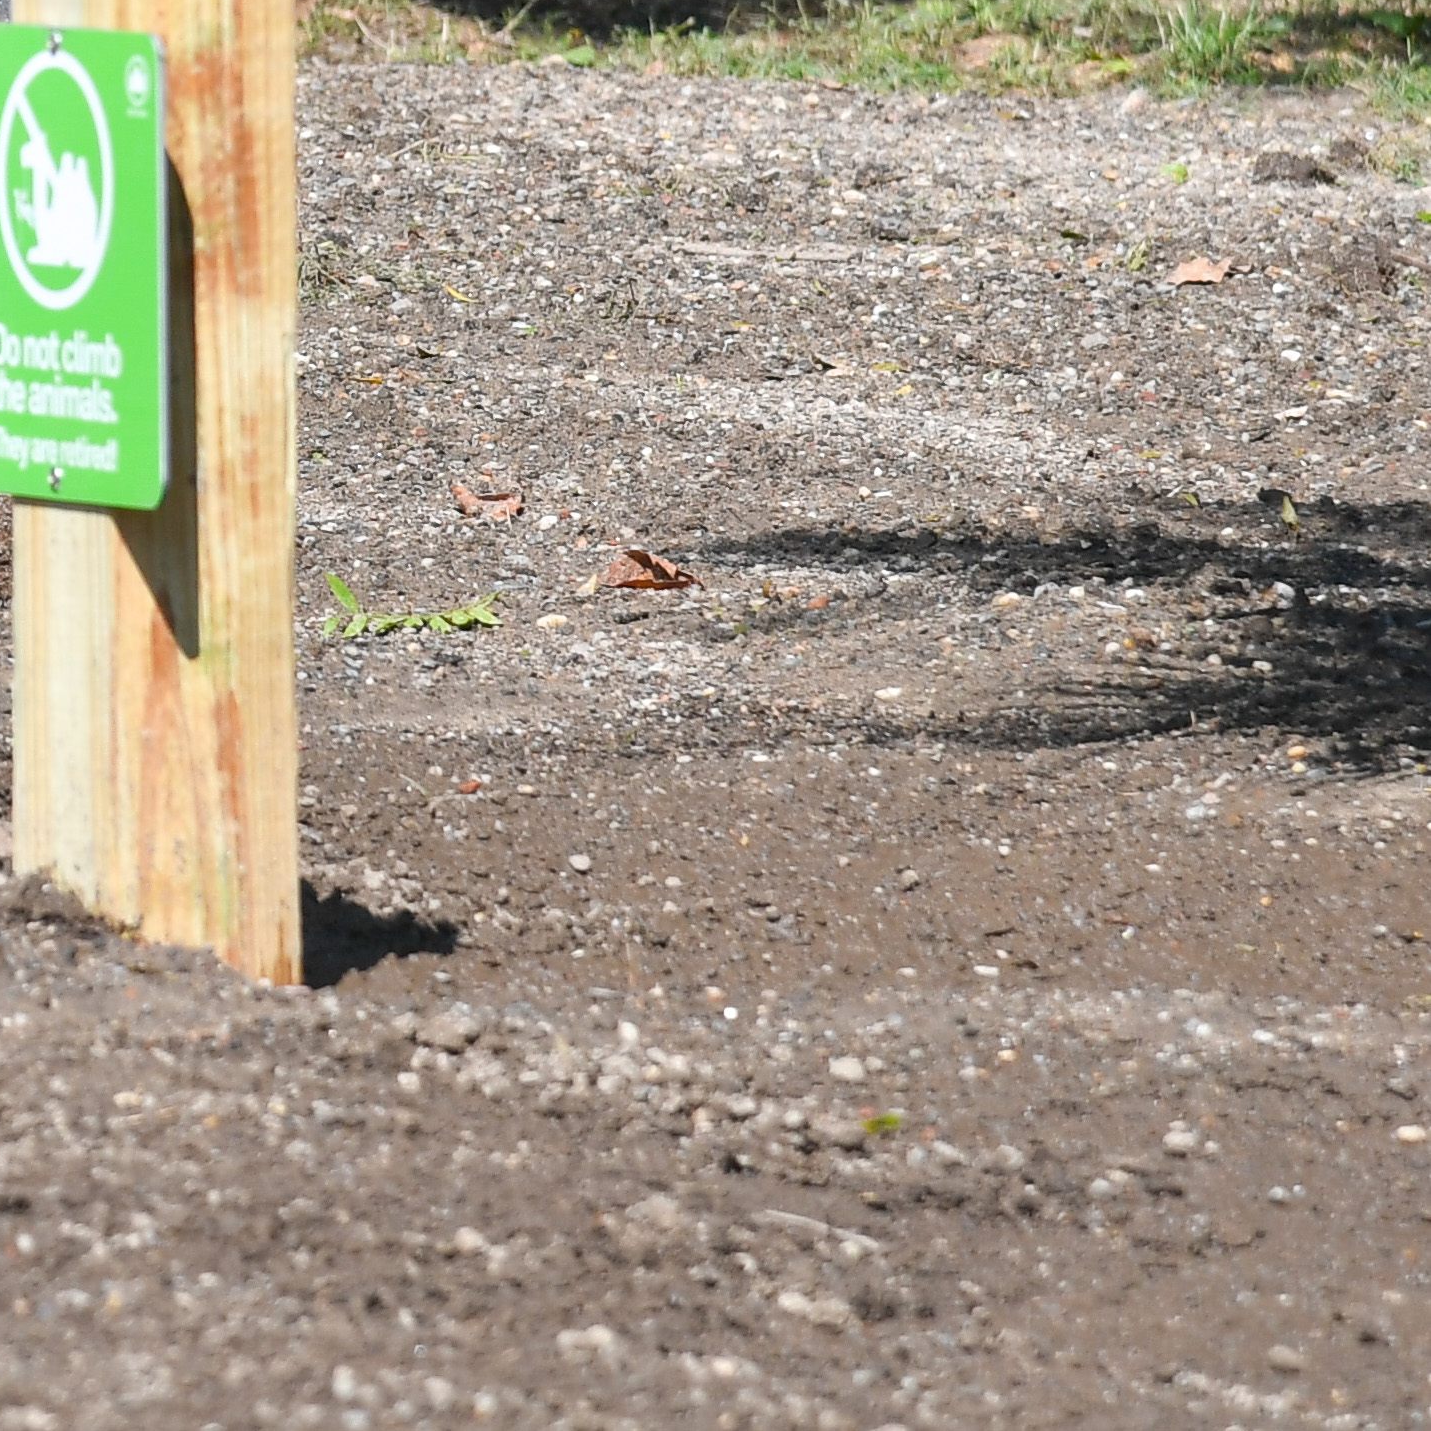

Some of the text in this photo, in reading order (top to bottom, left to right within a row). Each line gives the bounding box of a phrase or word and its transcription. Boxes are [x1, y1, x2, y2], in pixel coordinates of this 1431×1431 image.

[23, 331, 59, 370] not
[60, 331, 122, 377] climb
[27, 373, 118, 422] animals.
[30, 437, 58, 463] are
